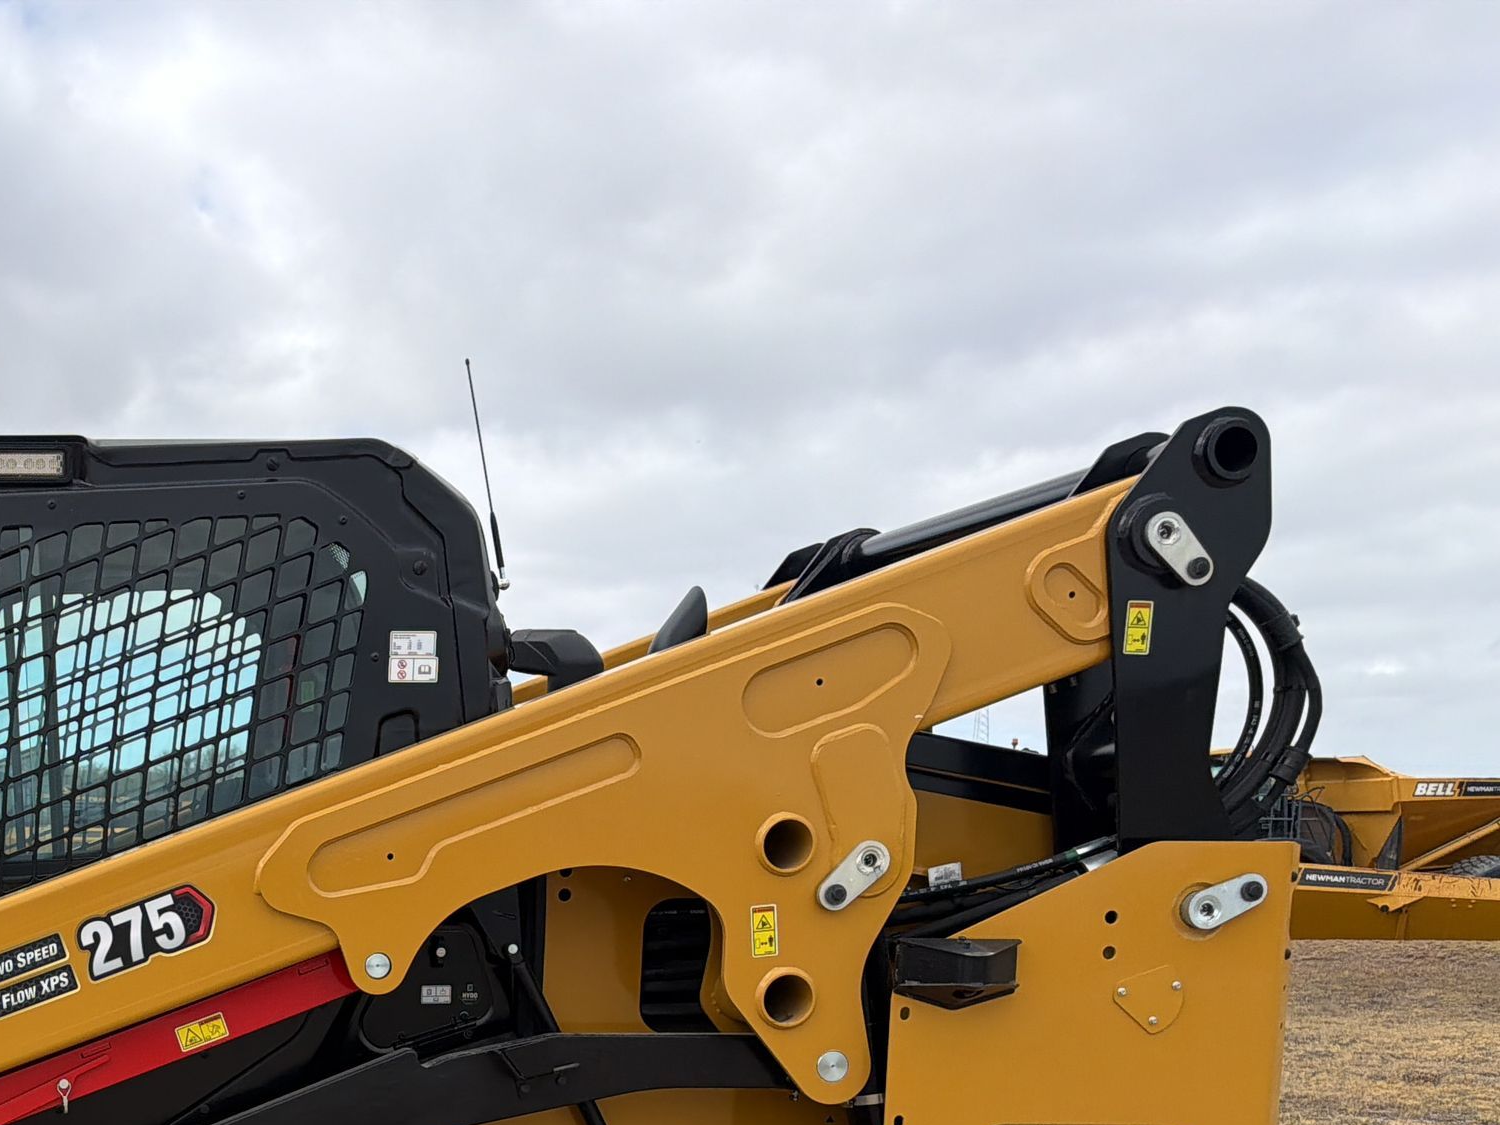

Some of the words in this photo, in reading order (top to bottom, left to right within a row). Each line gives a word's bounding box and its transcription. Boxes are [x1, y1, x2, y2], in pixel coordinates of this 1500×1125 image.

[1414, 782, 1455, 796] BELL
[1305, 872, 1385, 886] NEWMANTRACTOR
[79, 893, 186, 978] 275
[16, 941, 58, 969] SPEED
[2, 985, 36, 1011] FLOW
[40, 971, 70, 996] XPS
